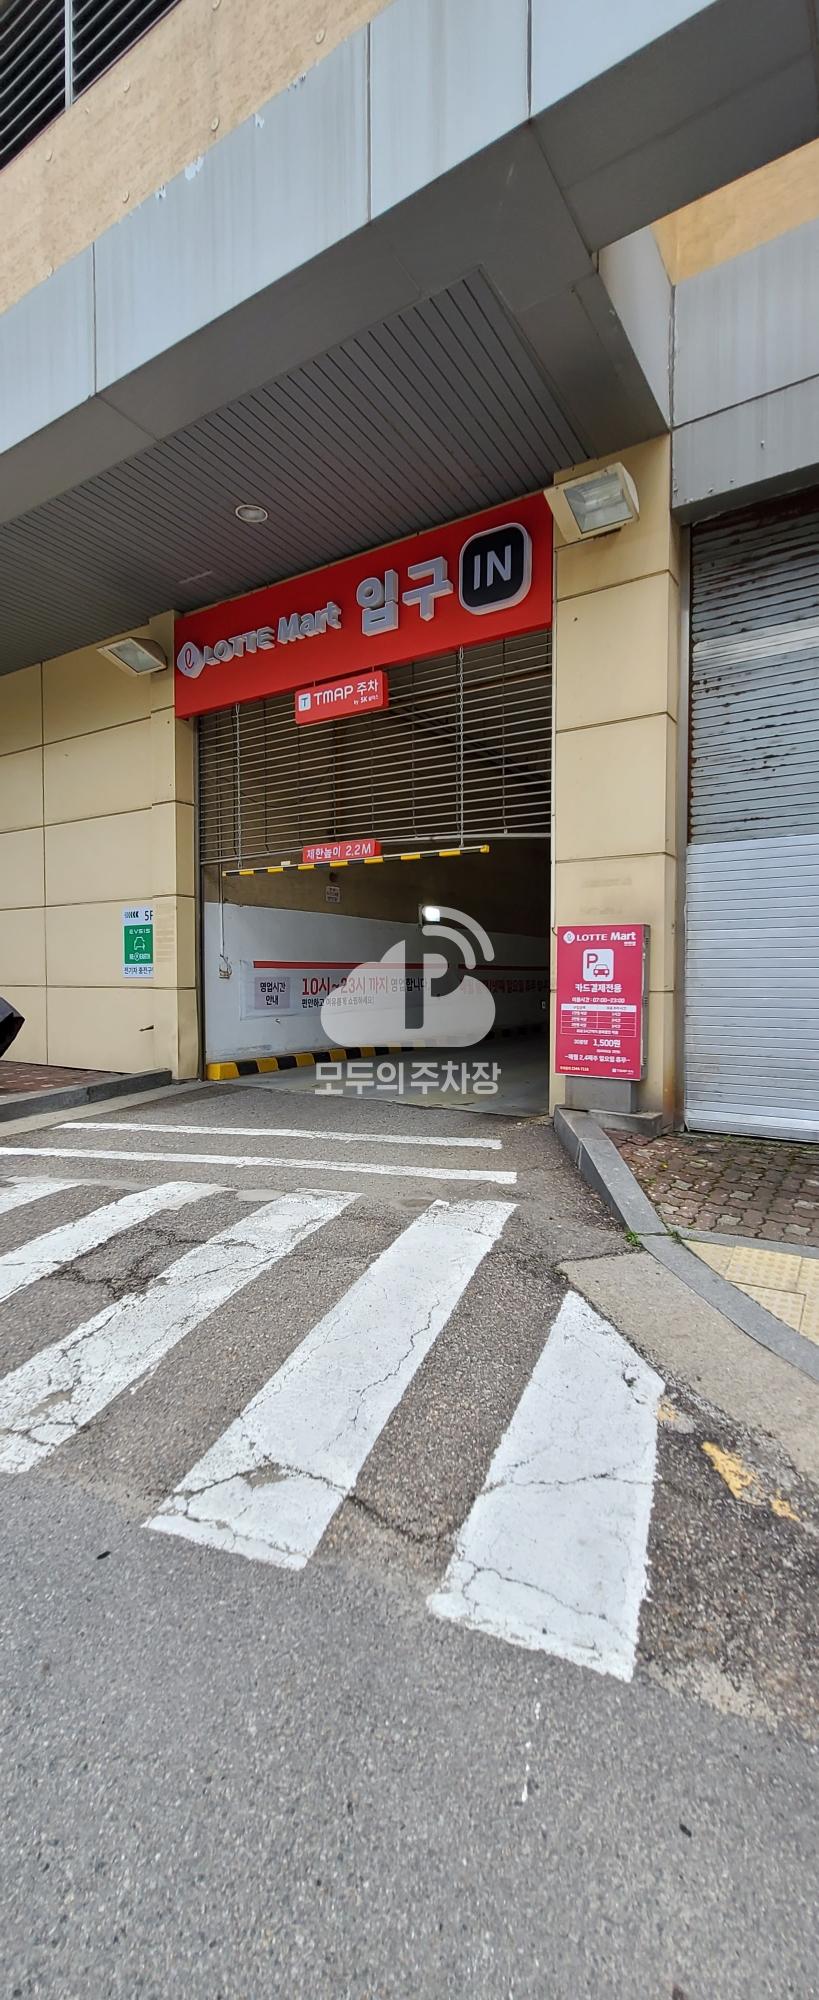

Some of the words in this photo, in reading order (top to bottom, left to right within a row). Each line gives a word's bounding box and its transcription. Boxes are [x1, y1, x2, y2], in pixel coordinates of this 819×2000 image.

[473, 545, 512, 590] IN
[203, 626, 275, 666] LOTTE
[277, 602, 342, 644] Mart
[356, 556, 453, 637] 입구
[313, 685, 354, 706] TMAP
[356, 679, 379, 695] 주차
[306, 845, 341, 860] 제한높이
[345, 843, 371, 857] 2.2M
[576, 933, 608, 942] LOTTE
[610, 931, 637, 941] Mart
[586, 953, 599, 968] P
[260, 981, 287, 993] 영업시간
[575, 983, 623, 993] 카드결제전용
[265, 994, 279, 1005] 안내
[593, 1038, 621, 1048] 1,500원
